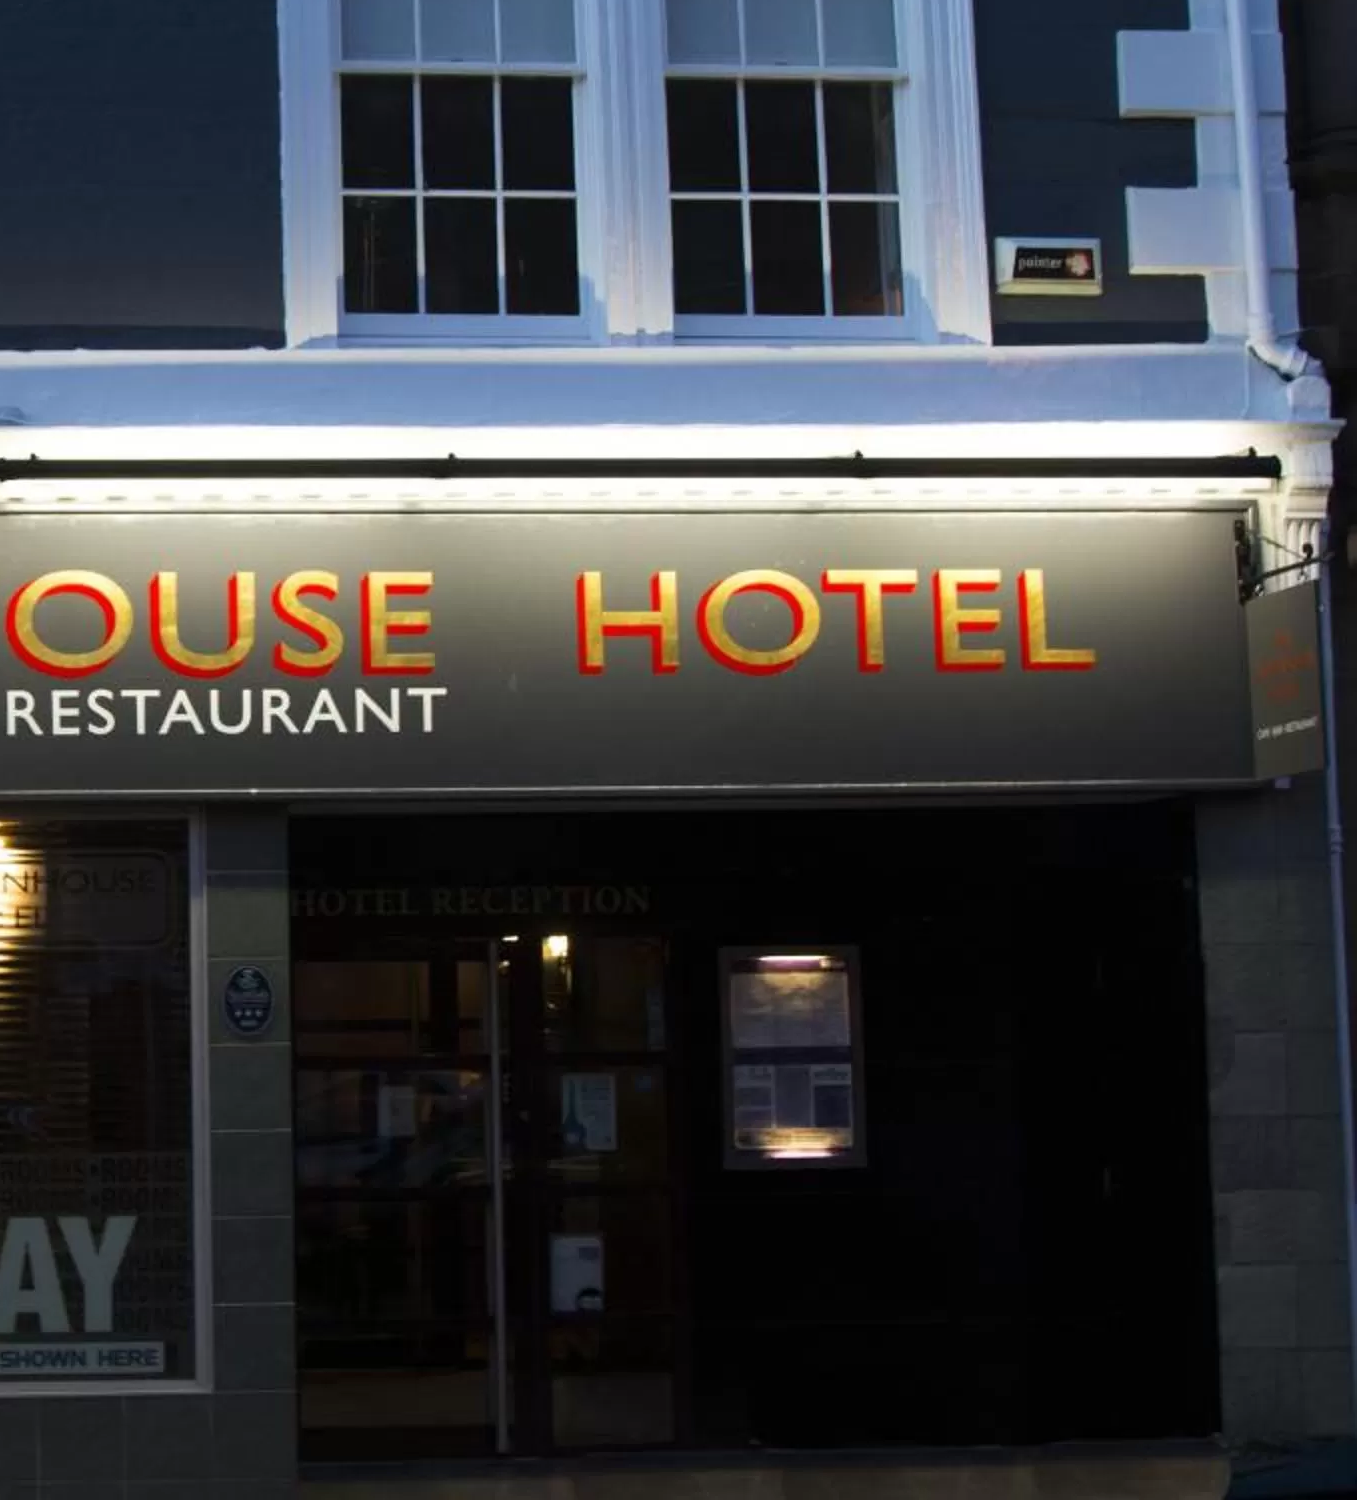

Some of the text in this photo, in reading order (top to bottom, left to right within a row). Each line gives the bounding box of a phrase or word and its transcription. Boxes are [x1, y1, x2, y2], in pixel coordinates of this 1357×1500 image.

[577, 568, 1097, 675] HOTEL
[6, 687, 448, 736] RESTAURANT
[291, 884, 653, 917] HOTEL RECEPTION
[0, 1349, 87, 1368] SHOWN
[97, 1347, 160, 1367] HERE
